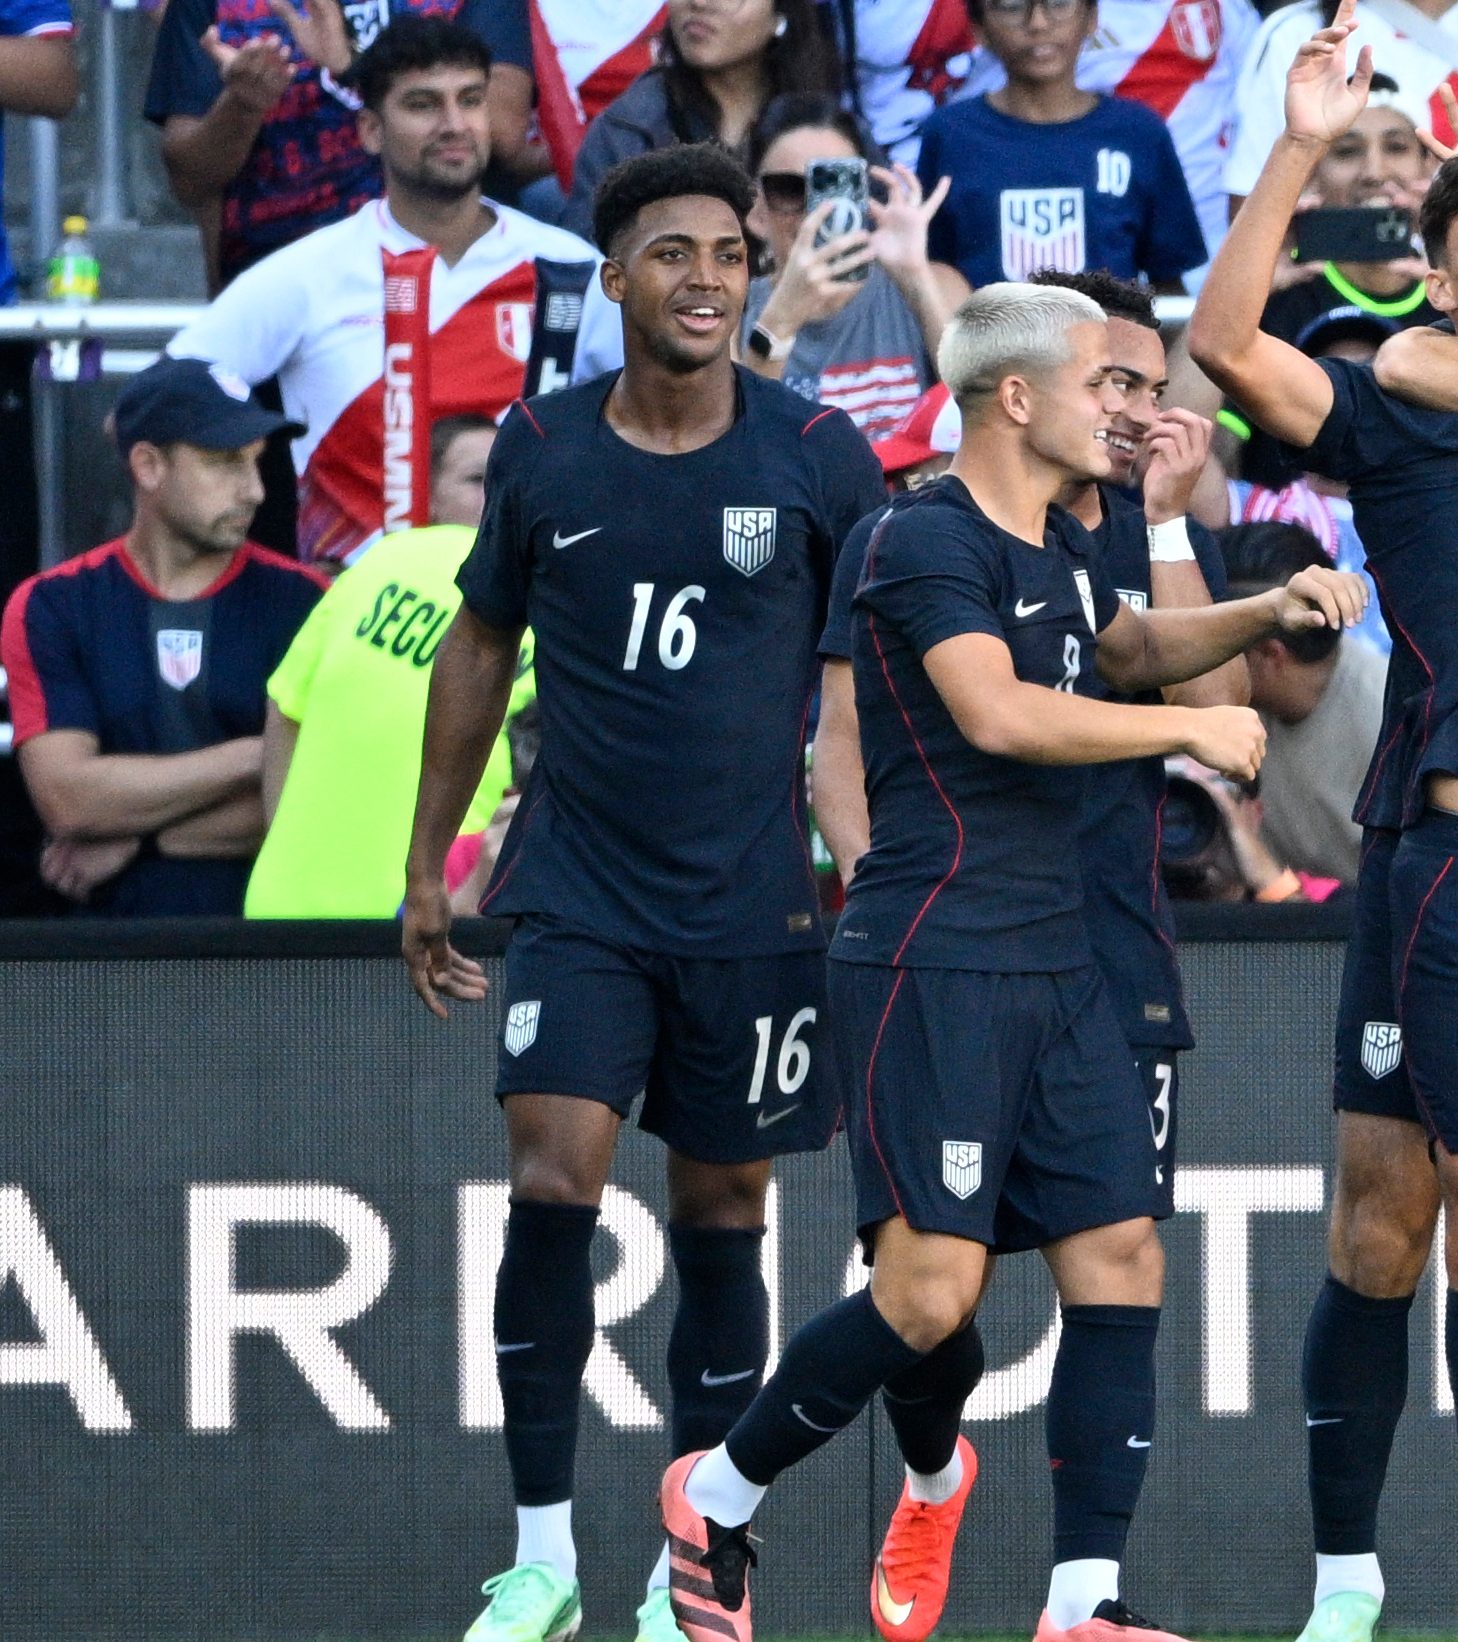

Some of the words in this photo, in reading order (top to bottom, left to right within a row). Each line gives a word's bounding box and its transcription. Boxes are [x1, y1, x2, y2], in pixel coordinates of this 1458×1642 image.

[1097, 147, 1132, 197] 10
[1010, 198, 1076, 236] USA
[728, 511, 772, 538] USA
[355, 583, 450, 668] SECU
[623, 583, 706, 671] 16
[509, 1003, 537, 1027] USA
[1366, 1025, 1402, 1048] USA
[747, 1006, 817, 1104] 16
[946, 1145, 980, 1168] USA
[0, 1164, 1453, 1433] ARRT
